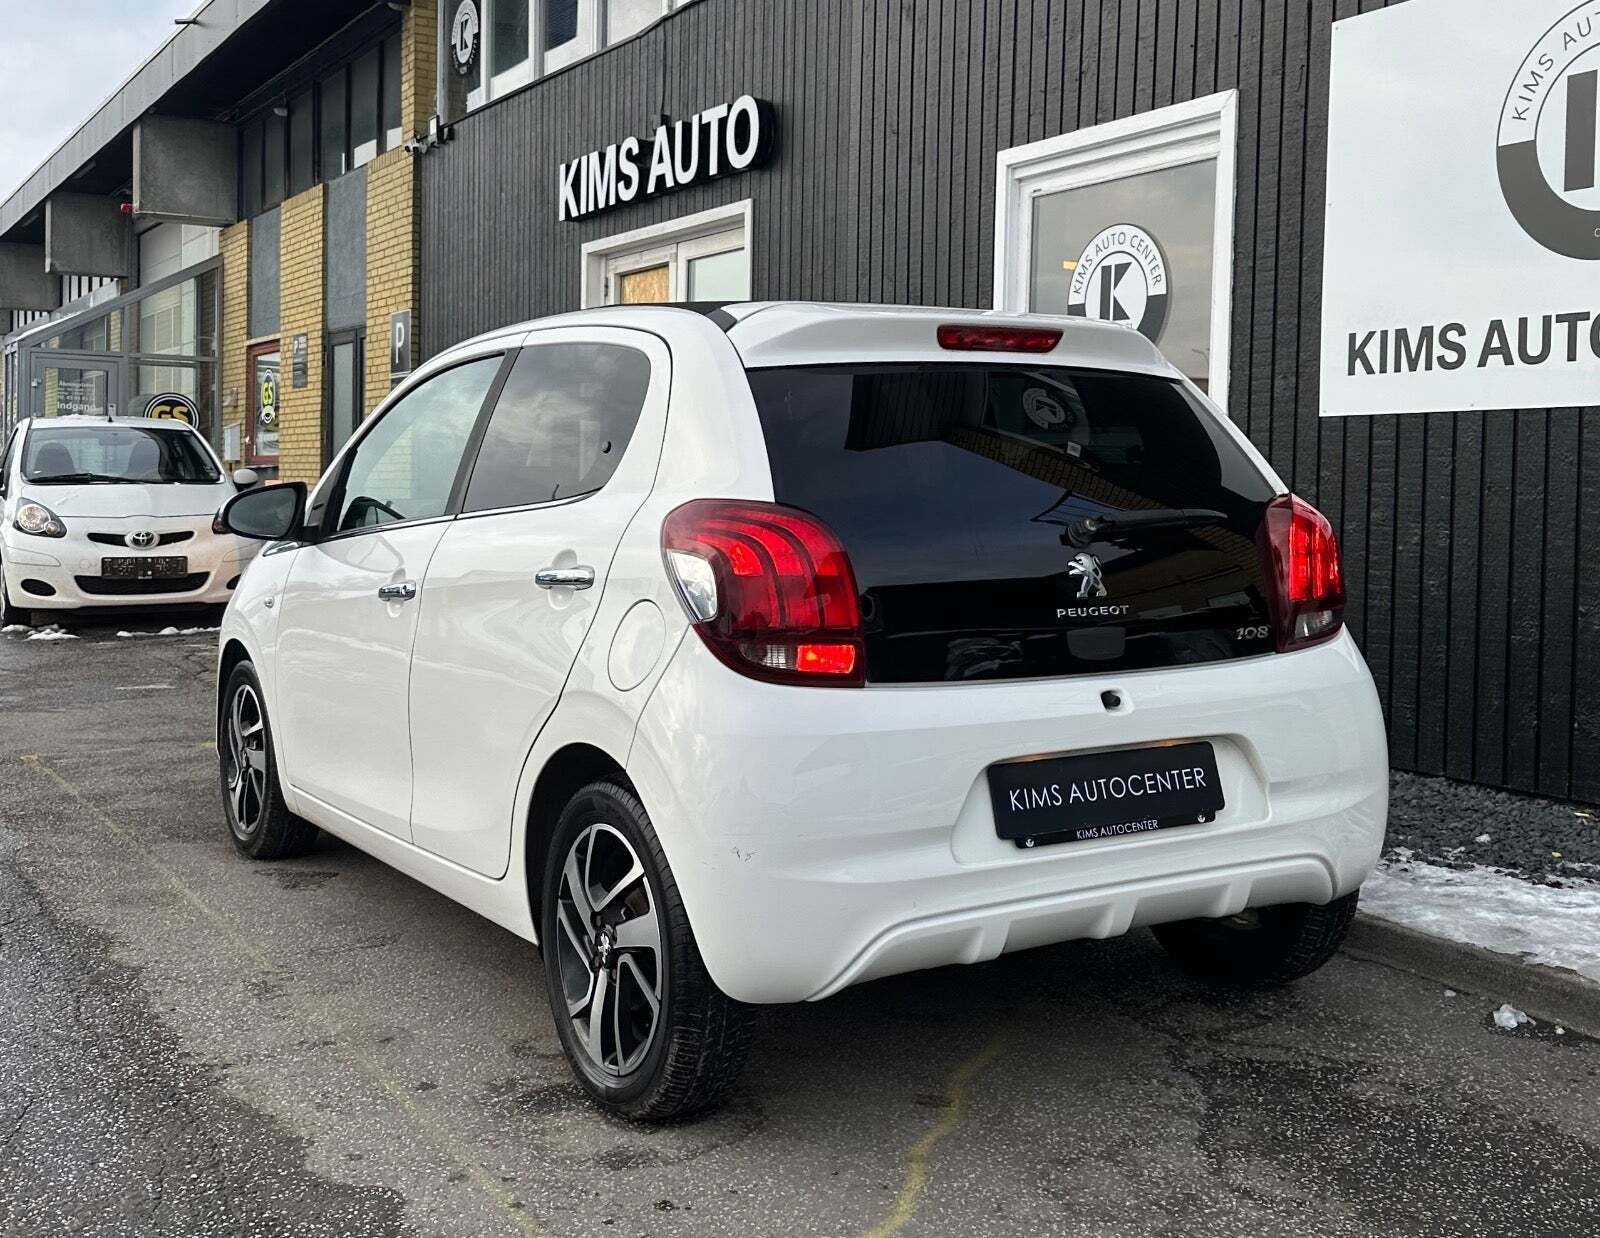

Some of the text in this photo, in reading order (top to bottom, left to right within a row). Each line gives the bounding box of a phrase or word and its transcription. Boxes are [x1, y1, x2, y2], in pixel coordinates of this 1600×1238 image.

[1512, 53, 1554, 120] KIMS
[1563, 11, 1600, 51] AU
[559, 94, 759, 221] KIMS AUTO
[1073, 232, 1162, 294] KIMS AUTO CENTER
[395, 322, 405, 364] P
[1347, 322, 1467, 376] KIMS
[1057, 605, 1130, 618] PEUGEOT
[1235, 625, 1269, 640] 108
[1009, 767, 1207, 812] KIMS AUTOCENTER
[1076, 819, 1159, 840] KIMS AUTOCENTER
